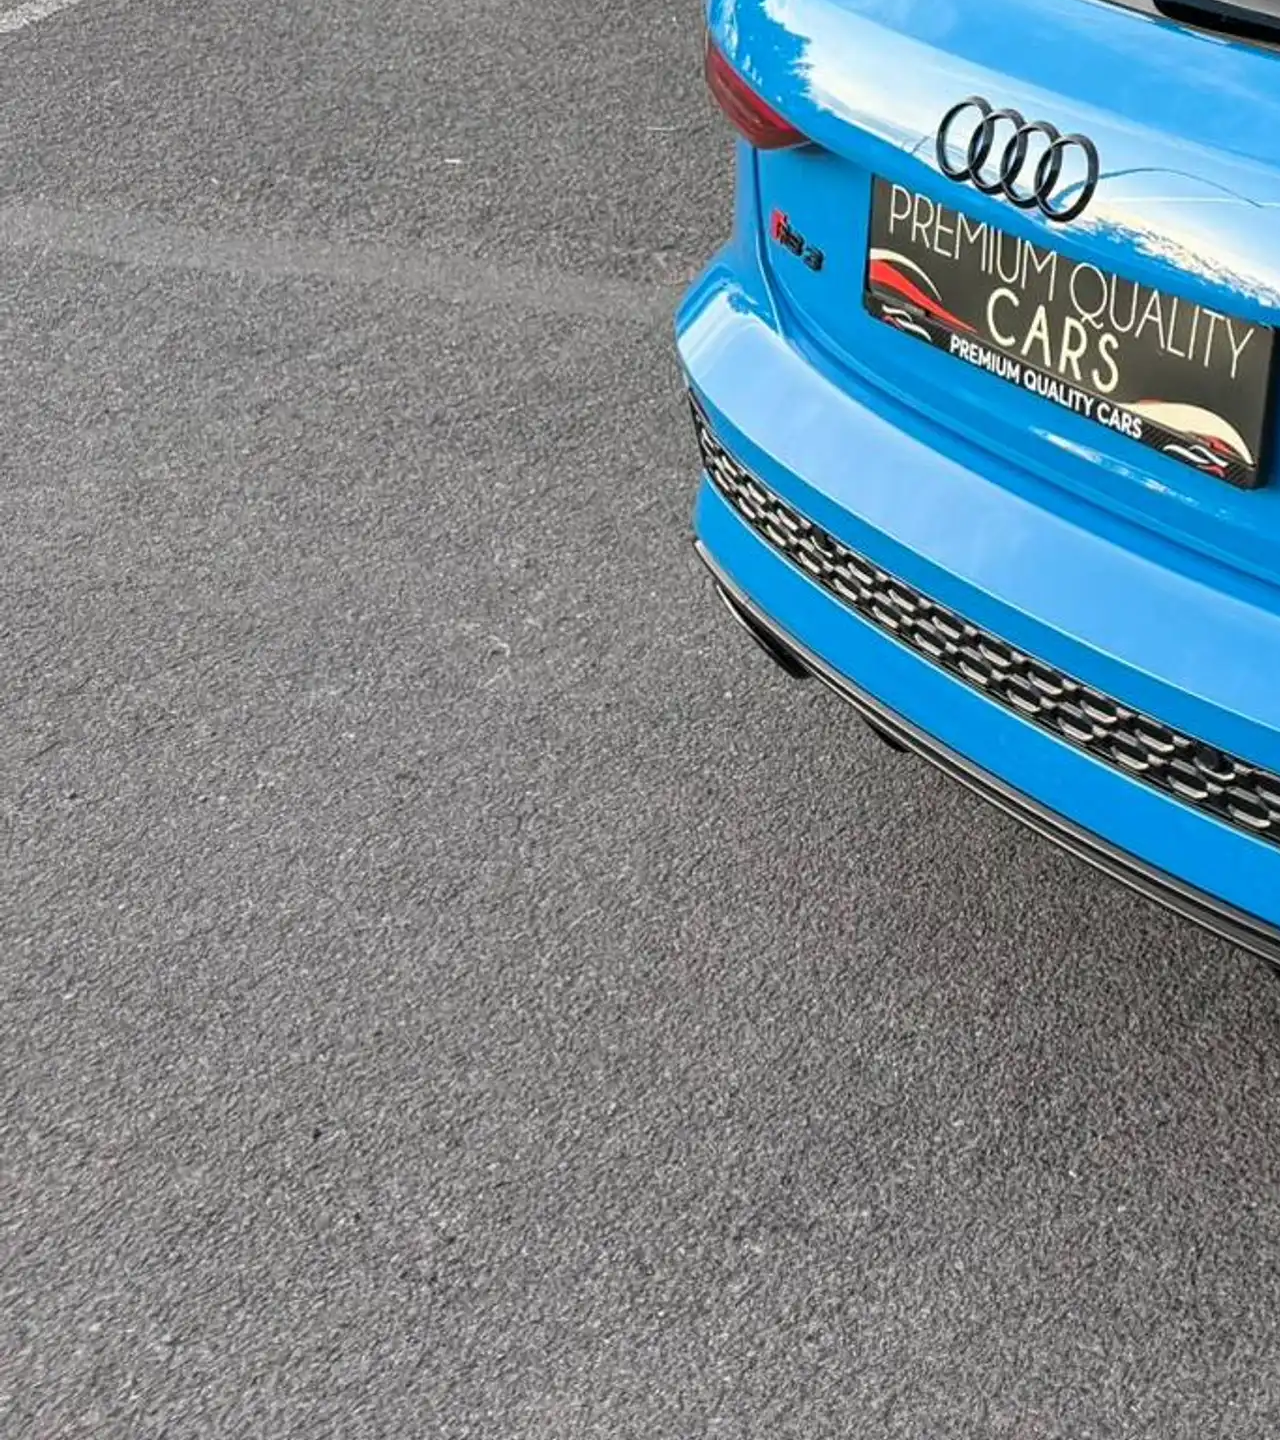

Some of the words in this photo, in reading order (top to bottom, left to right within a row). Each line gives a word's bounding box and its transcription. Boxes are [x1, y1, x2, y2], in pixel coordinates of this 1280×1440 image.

[889, 183, 1057, 301] PREMIUM
[1070, 262, 1254, 380] QUALITY
[950, 335, 1021, 384] PREMIUM
[1023, 370, 1096, 417] QUALITY
[1096, 402, 1143, 440] CARS
[987, 287, 1119, 393] CARS
